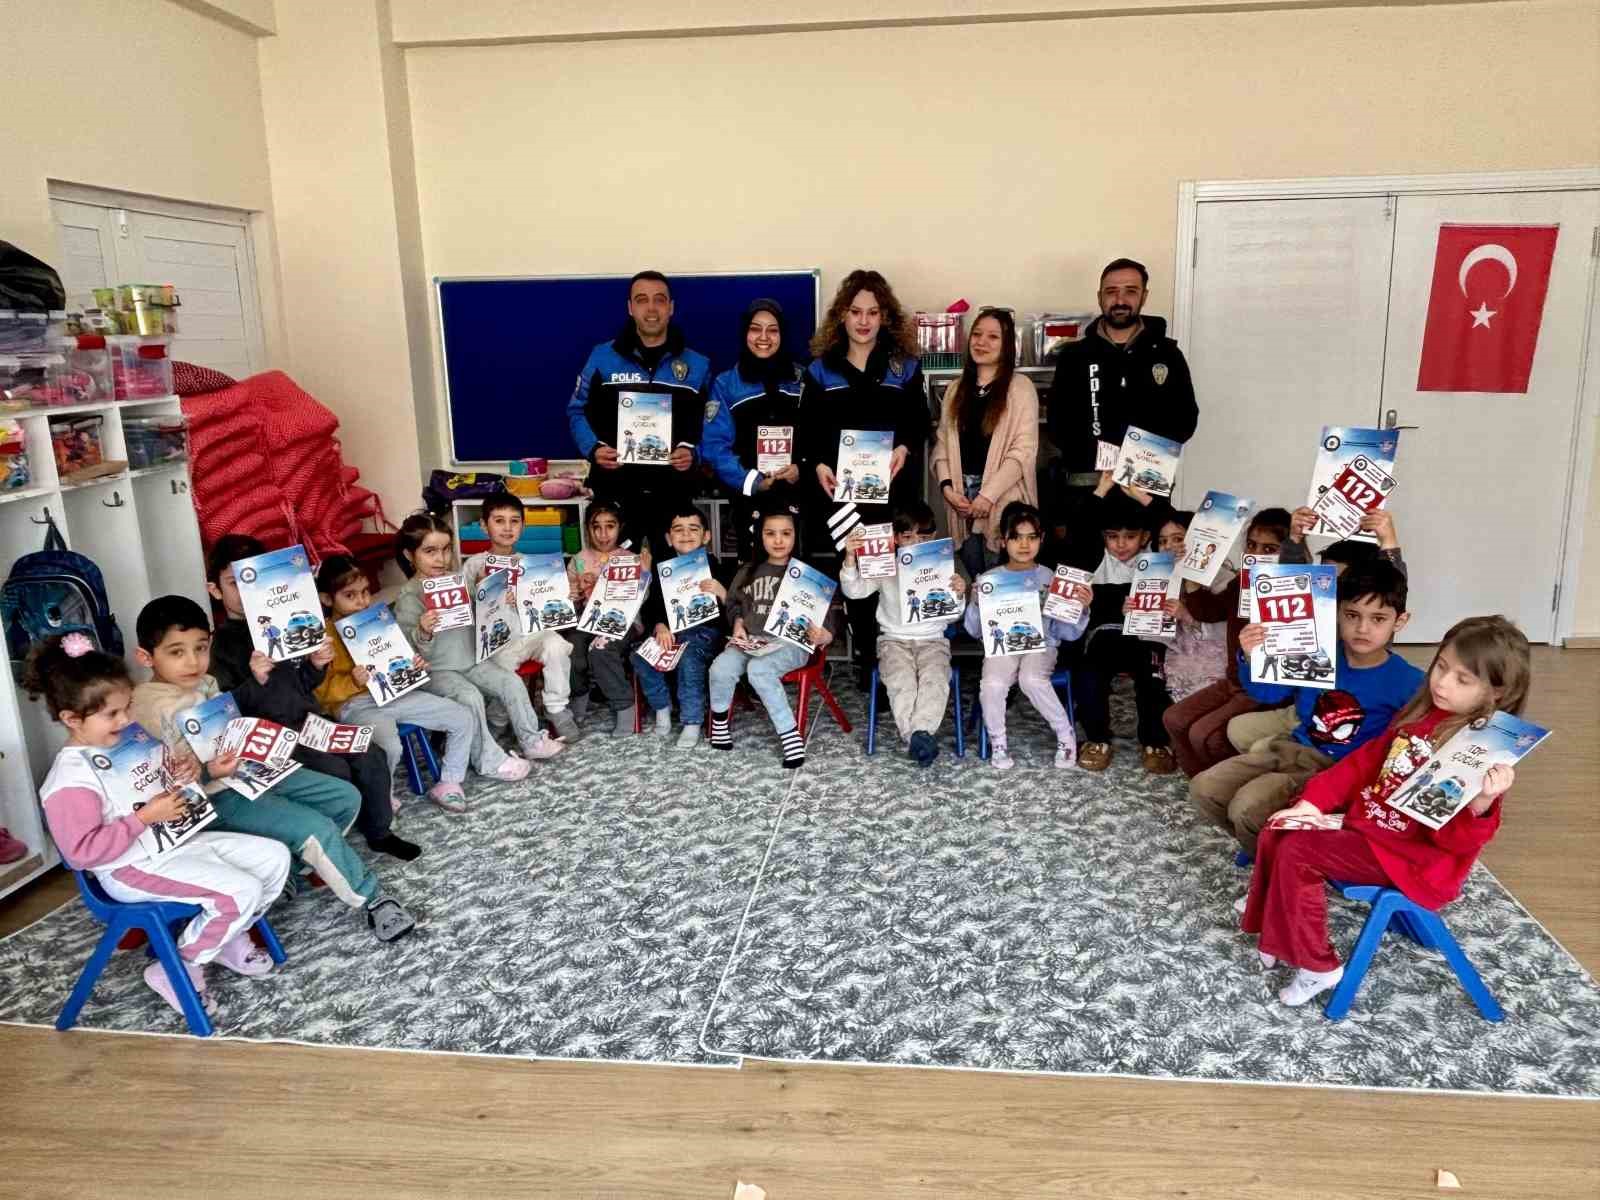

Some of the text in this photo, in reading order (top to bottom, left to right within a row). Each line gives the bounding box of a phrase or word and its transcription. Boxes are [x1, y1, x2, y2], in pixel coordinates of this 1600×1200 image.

[763, 440, 786, 453] 112
[1341, 475, 1376, 509] 112
[864, 539, 889, 554] 112
[613, 567, 636, 580] 112
[271, 583, 289, 596] TDP
[266, 591, 301, 609] ÇOCUK
[431, 589, 463, 608] 112
[1138, 594, 1161, 609] 112
[1266, 597, 1306, 619] 112
[245, 726, 277, 756] 112
[333, 729, 354, 750] 112
[130, 761, 150, 777] TDP
